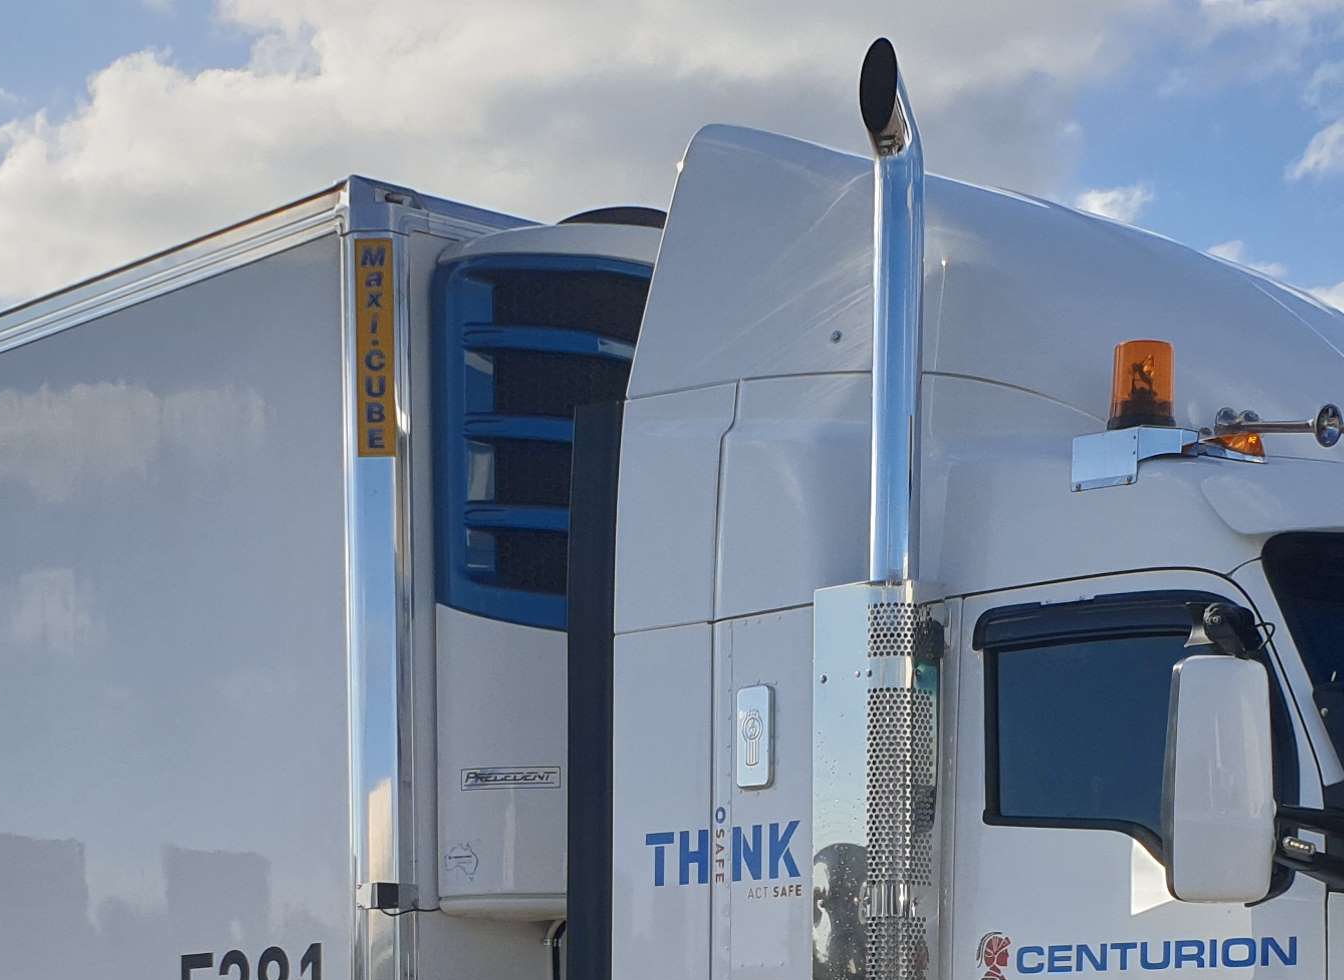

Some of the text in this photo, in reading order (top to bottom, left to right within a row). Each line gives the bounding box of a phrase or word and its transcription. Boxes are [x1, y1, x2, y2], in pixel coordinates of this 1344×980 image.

[747, 884, 803, 900] ACT SAFE
[1016, 935, 1298, 975] CENTURION
